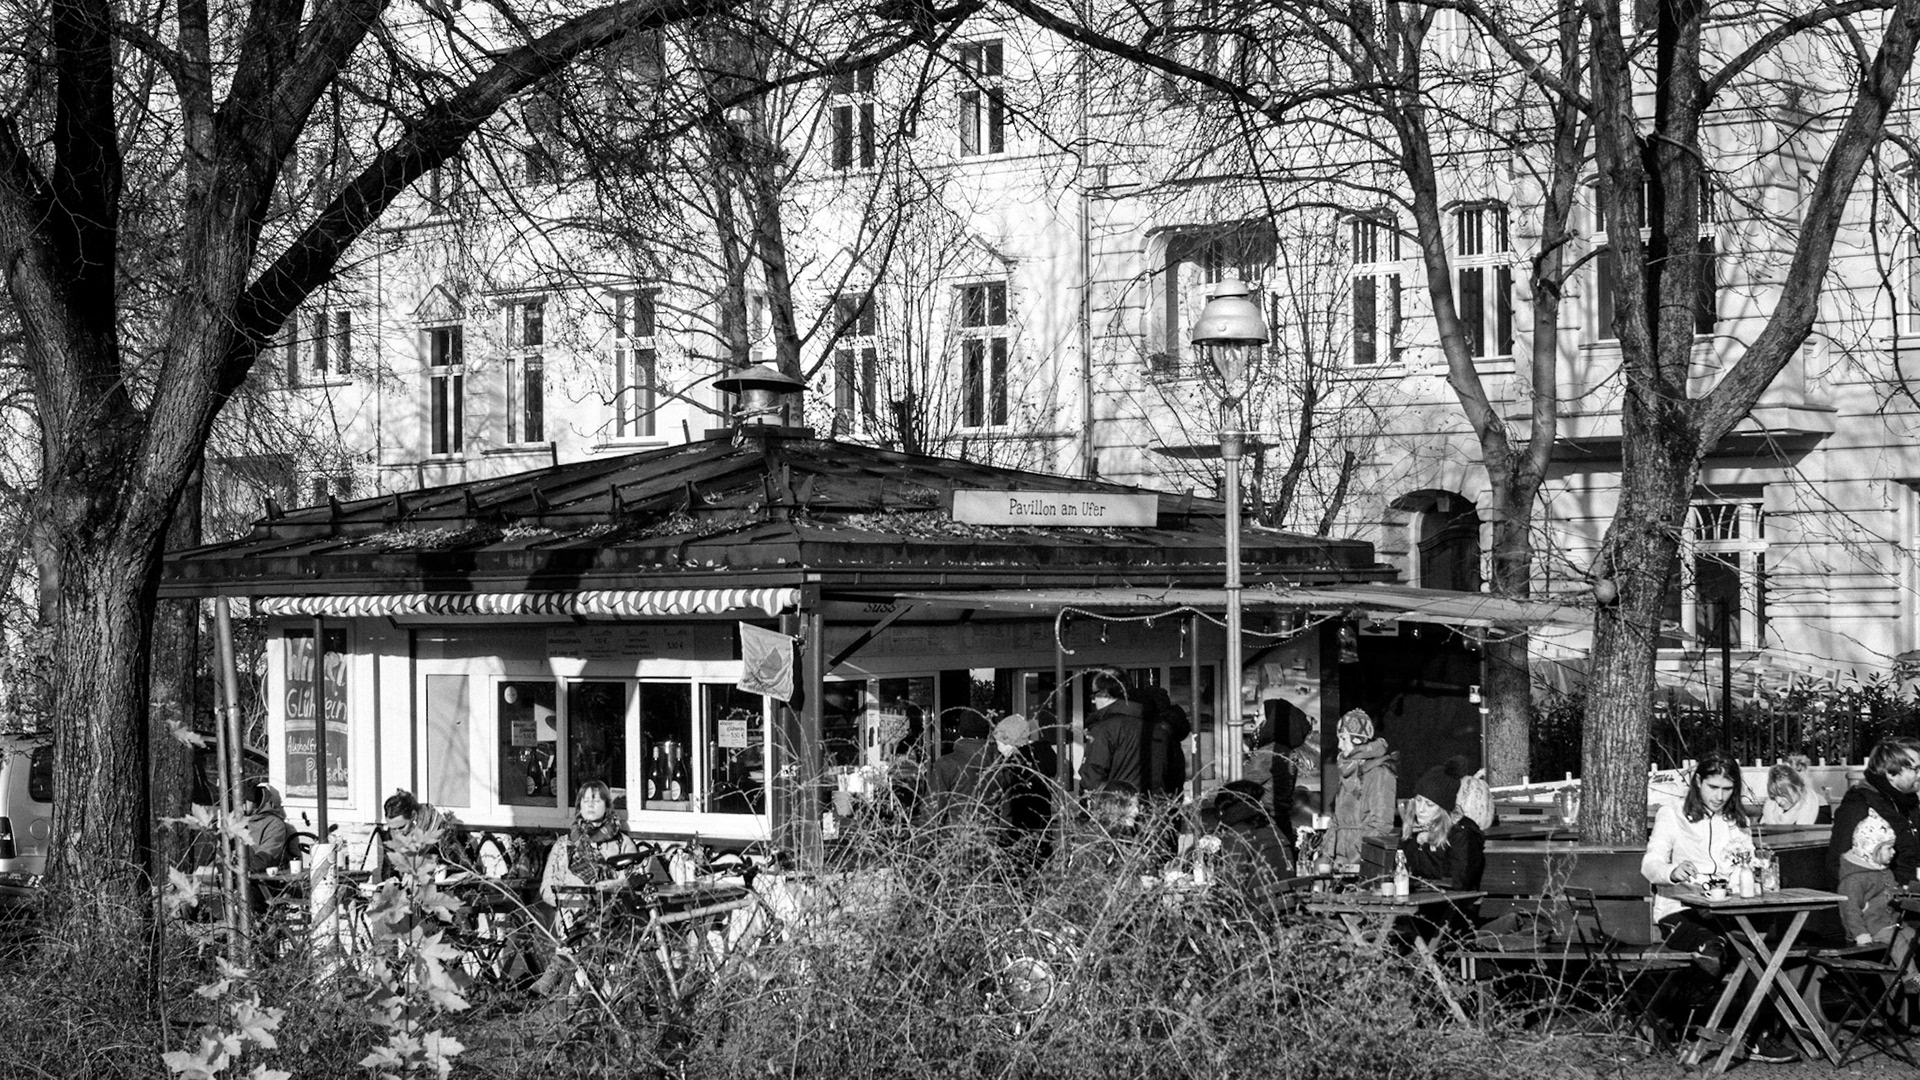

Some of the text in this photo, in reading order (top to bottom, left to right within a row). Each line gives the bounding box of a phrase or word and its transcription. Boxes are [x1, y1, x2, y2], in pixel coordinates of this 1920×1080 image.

[1009, 498, 1107, 517] Pavillon am Ufer
[286, 686, 348, 721] Glühein
